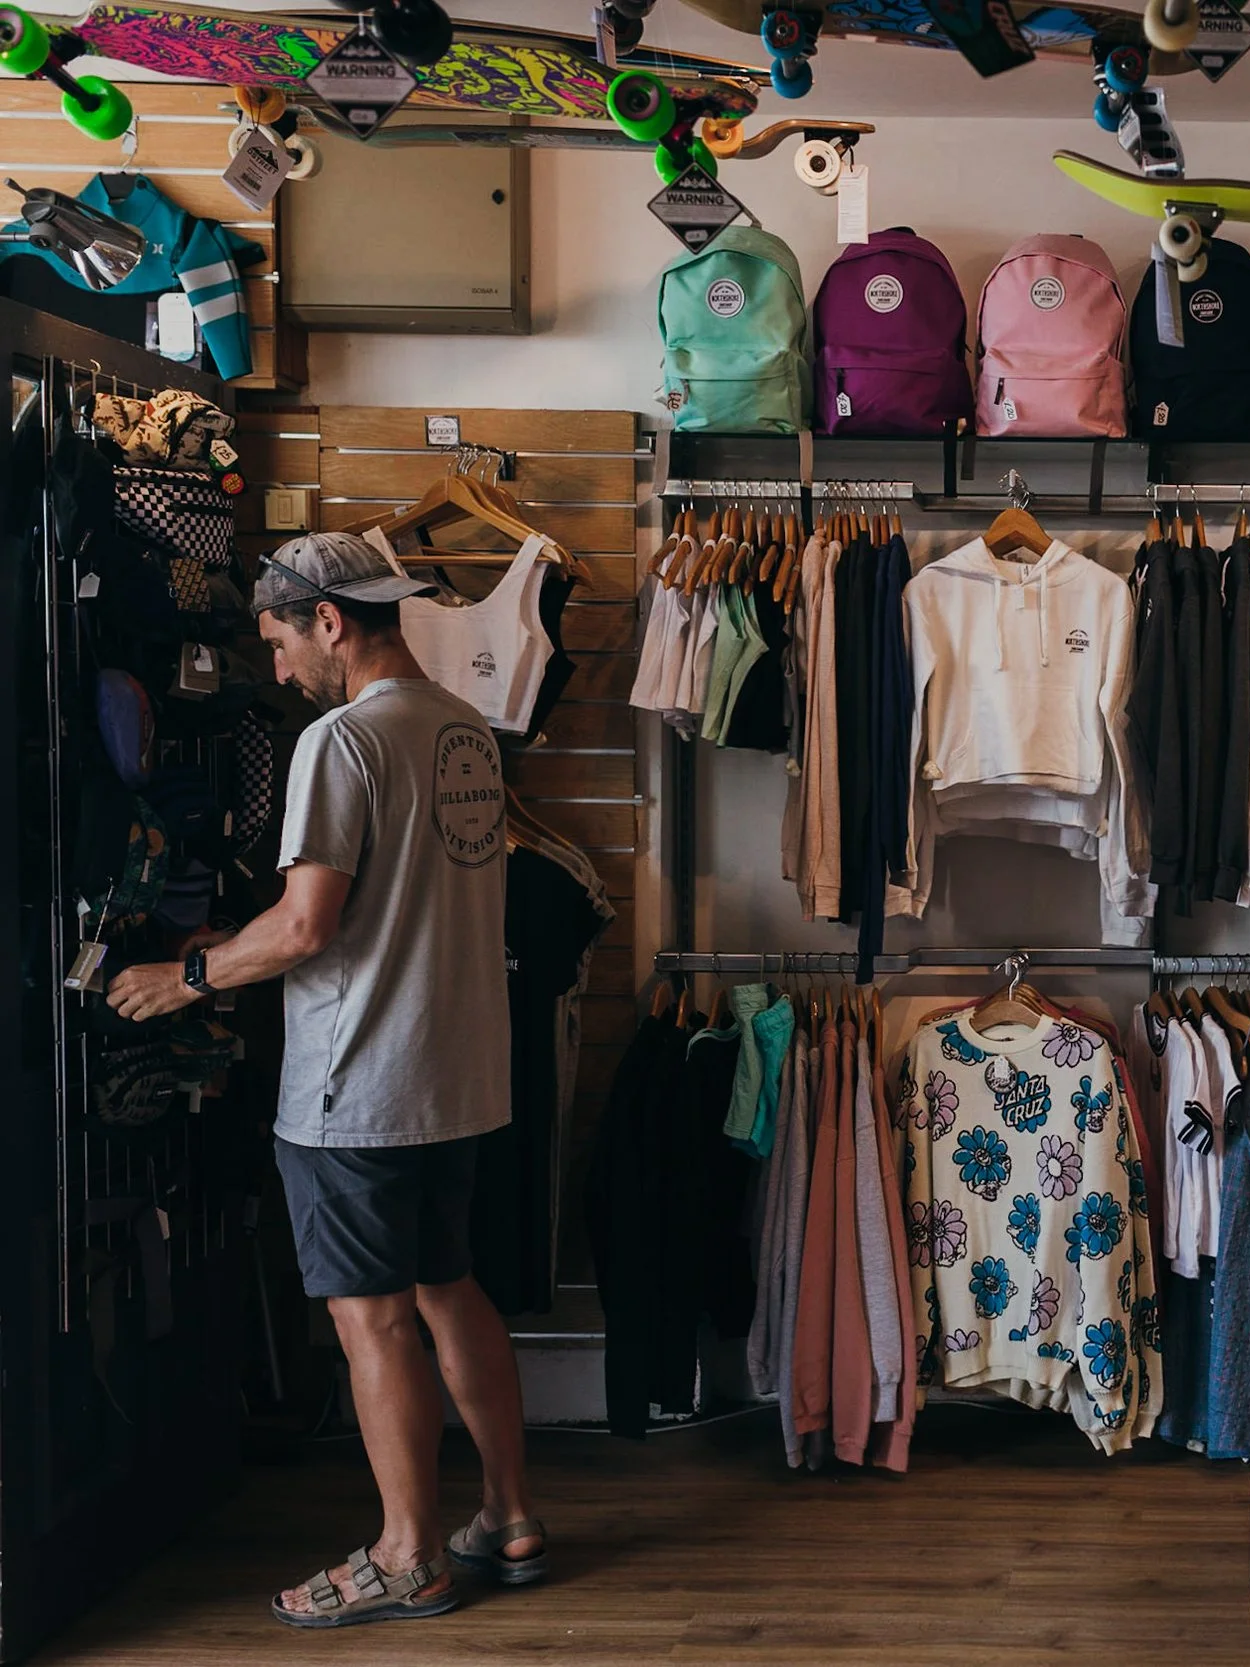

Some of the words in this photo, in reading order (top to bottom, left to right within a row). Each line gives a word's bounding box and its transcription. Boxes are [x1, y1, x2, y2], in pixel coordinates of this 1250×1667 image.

[1198, 20, 1243, 32] ARNING
[326, 62, 397, 78] WARNING
[667, 192, 725, 206] WARNING
[839, 395, 848, 414] £20
[1004, 403, 1015, 421] £20
[1157, 407, 1166, 423] £20
[440, 734, 500, 777] ADVENTURE
[1006, 1096, 1046, 1126] CRUZ
